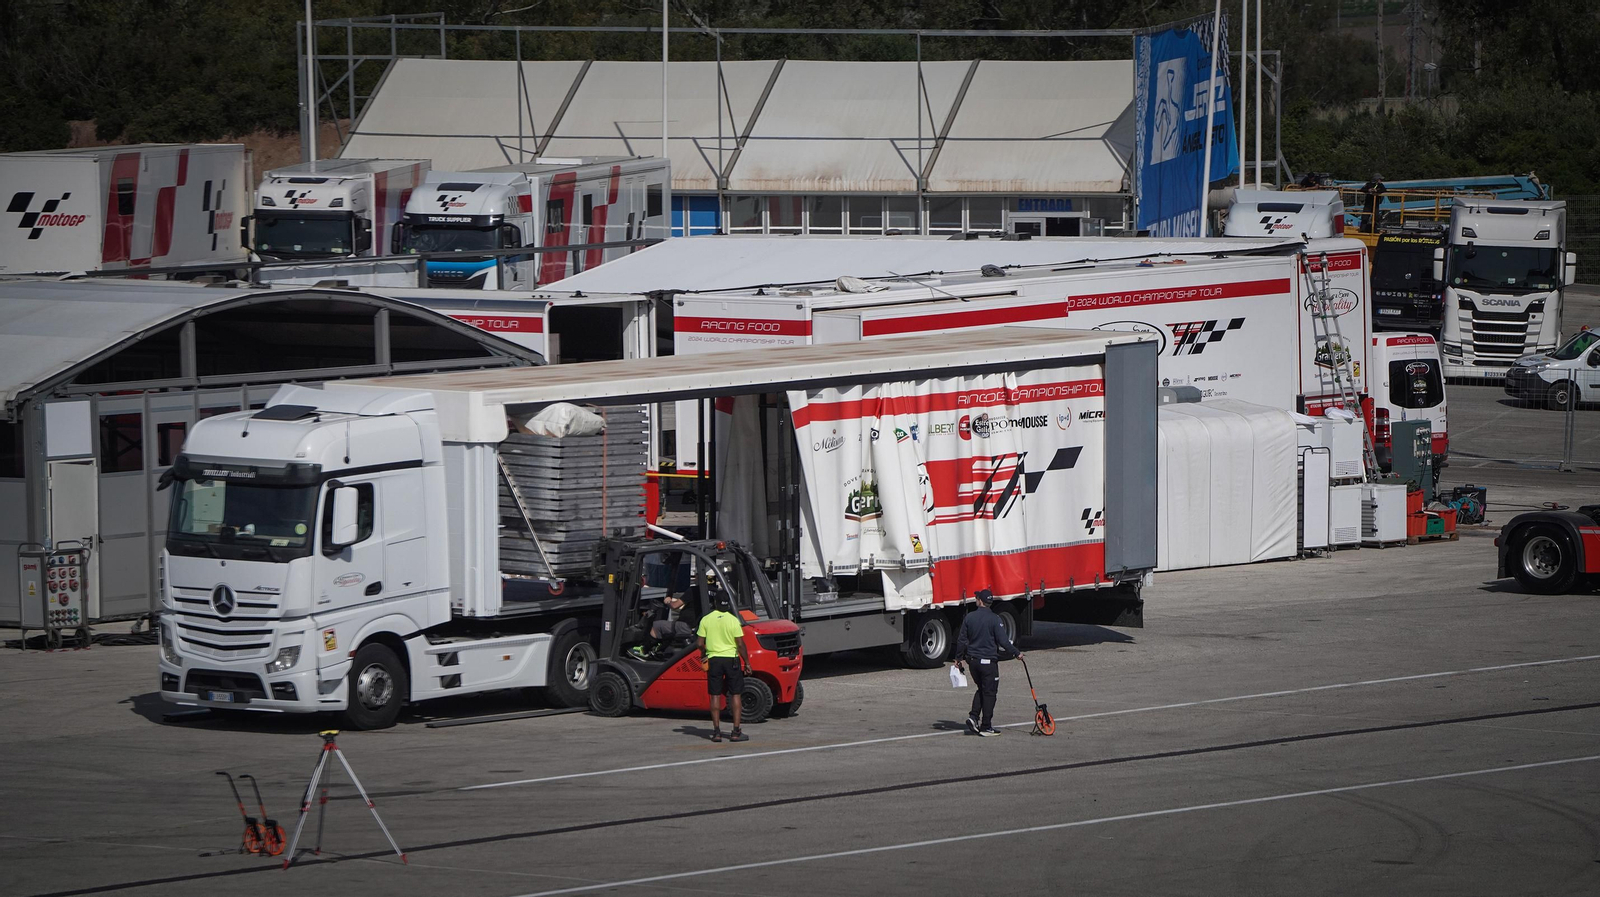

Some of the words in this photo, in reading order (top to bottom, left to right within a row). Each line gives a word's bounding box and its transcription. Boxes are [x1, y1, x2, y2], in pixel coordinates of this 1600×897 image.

[1018, 199, 1073, 212] ENTRADA
[1076, 298, 1097, 307] 2024
[1098, 294, 1131, 306] WORLD
[1132, 289, 1197, 303] CHAMPIONSHIP
[1199, 287, 1223, 297] TOUR
[1482, 298, 1521, 307] SCANIA
[487, 320, 520, 329] TOUR
[701, 320, 746, 331] RACING
[747, 322, 781, 332] FOOD
[728, 337, 775, 345] CHAMPIONSHIP
